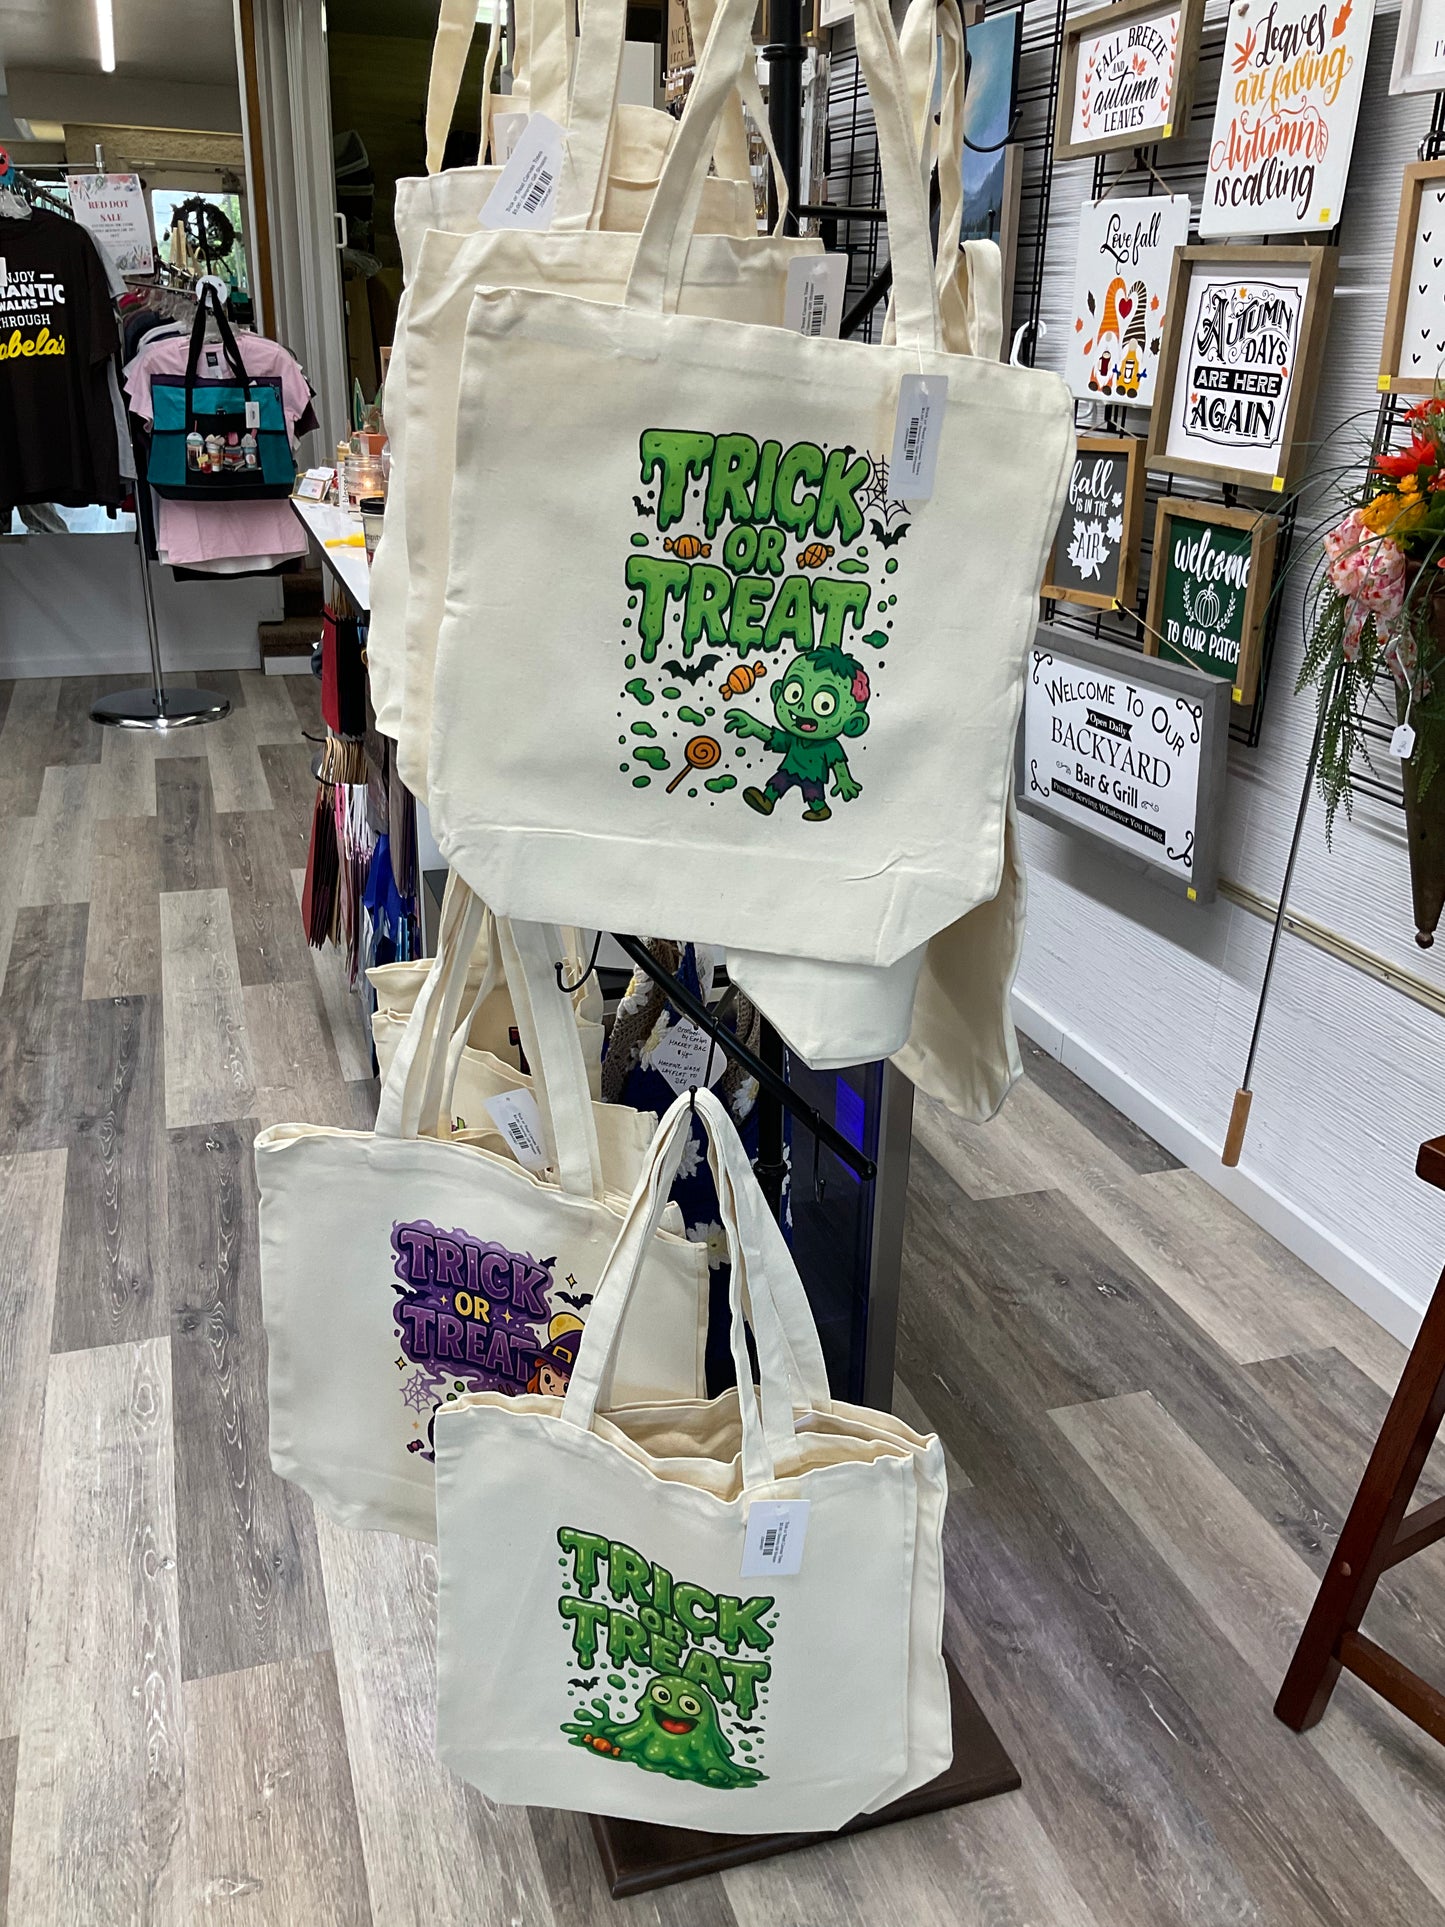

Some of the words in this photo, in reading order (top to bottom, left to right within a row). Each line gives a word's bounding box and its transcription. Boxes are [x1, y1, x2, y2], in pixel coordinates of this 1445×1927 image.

[1095, 45, 1123, 81] FALL
[1127, 26, 1168, 65] BREEZE
[1255, 2, 1326, 67] Leaves
[1111, 62, 1125, 74] AND
[1264, 45, 1353, 116] falling
[1093, 71, 1160, 115] autumn
[1103, 105, 1144, 133] LEAVES
[1210, 100, 1329, 173] Autumn
[88, 201, 107, 209] RED
[109, 200, 129, 209] DOT
[1231, 158, 1315, 220] calling
[100, 214, 122, 222] SALE
[1100, 213, 1134, 275] Love
[1130, 212, 1161, 266] fall
[0, 283, 65, 304] ANTIC
[6, 270, 35, 284] NJOY
[0, 313, 51, 328] HROUGH
[1197, 289, 1294, 364] AUTUMN
[1245, 333, 1288, 366] DAYS
[1197, 369, 1230, 389] ARE
[1234, 372, 1281, 395] HERE
[1190, 395, 1275, 439] AGAIN
[639, 428, 871, 546] TRICK
[1069, 458, 1114, 505] fall
[1075, 500, 1083, 512] IS
[1084, 499, 1093, 514] IN
[1094, 500, 1109, 517] THE
[723, 523, 786, 577] OR
[1076, 534, 1100, 559] AIR
[1174, 528, 1252, 590] welcome
[625, 554, 871, 663] TREAT
[1167, 619, 1180, 643] TO
[1182, 626, 1205, 652] OUR
[1089, 712, 1107, 729] Open
[1108, 718, 1128, 737] Daily
[1051, 715, 1172, 788] BACKYARD
[1075, 763, 1095, 789] Bar
[1098, 774, 1109, 795] &
[1113, 780, 1138, 809] Grill
[1053, 780, 1076, 798] Proudly
[1075, 791, 1098, 810] Serving
[1099, 803, 1129, 823] Whatever
[1130, 818, 1143, 831] You
[1144, 825, 1163, 841] Bring
[399, 1228, 548, 1318] TRICK
[454, 1291, 490, 1323] OR
[402, 1304, 538, 1383] TREAT
[557, 1526, 775, 1655] TRICK
[638, 1605, 689, 1649] OR
[558, 1595, 772, 1720] TREAT
